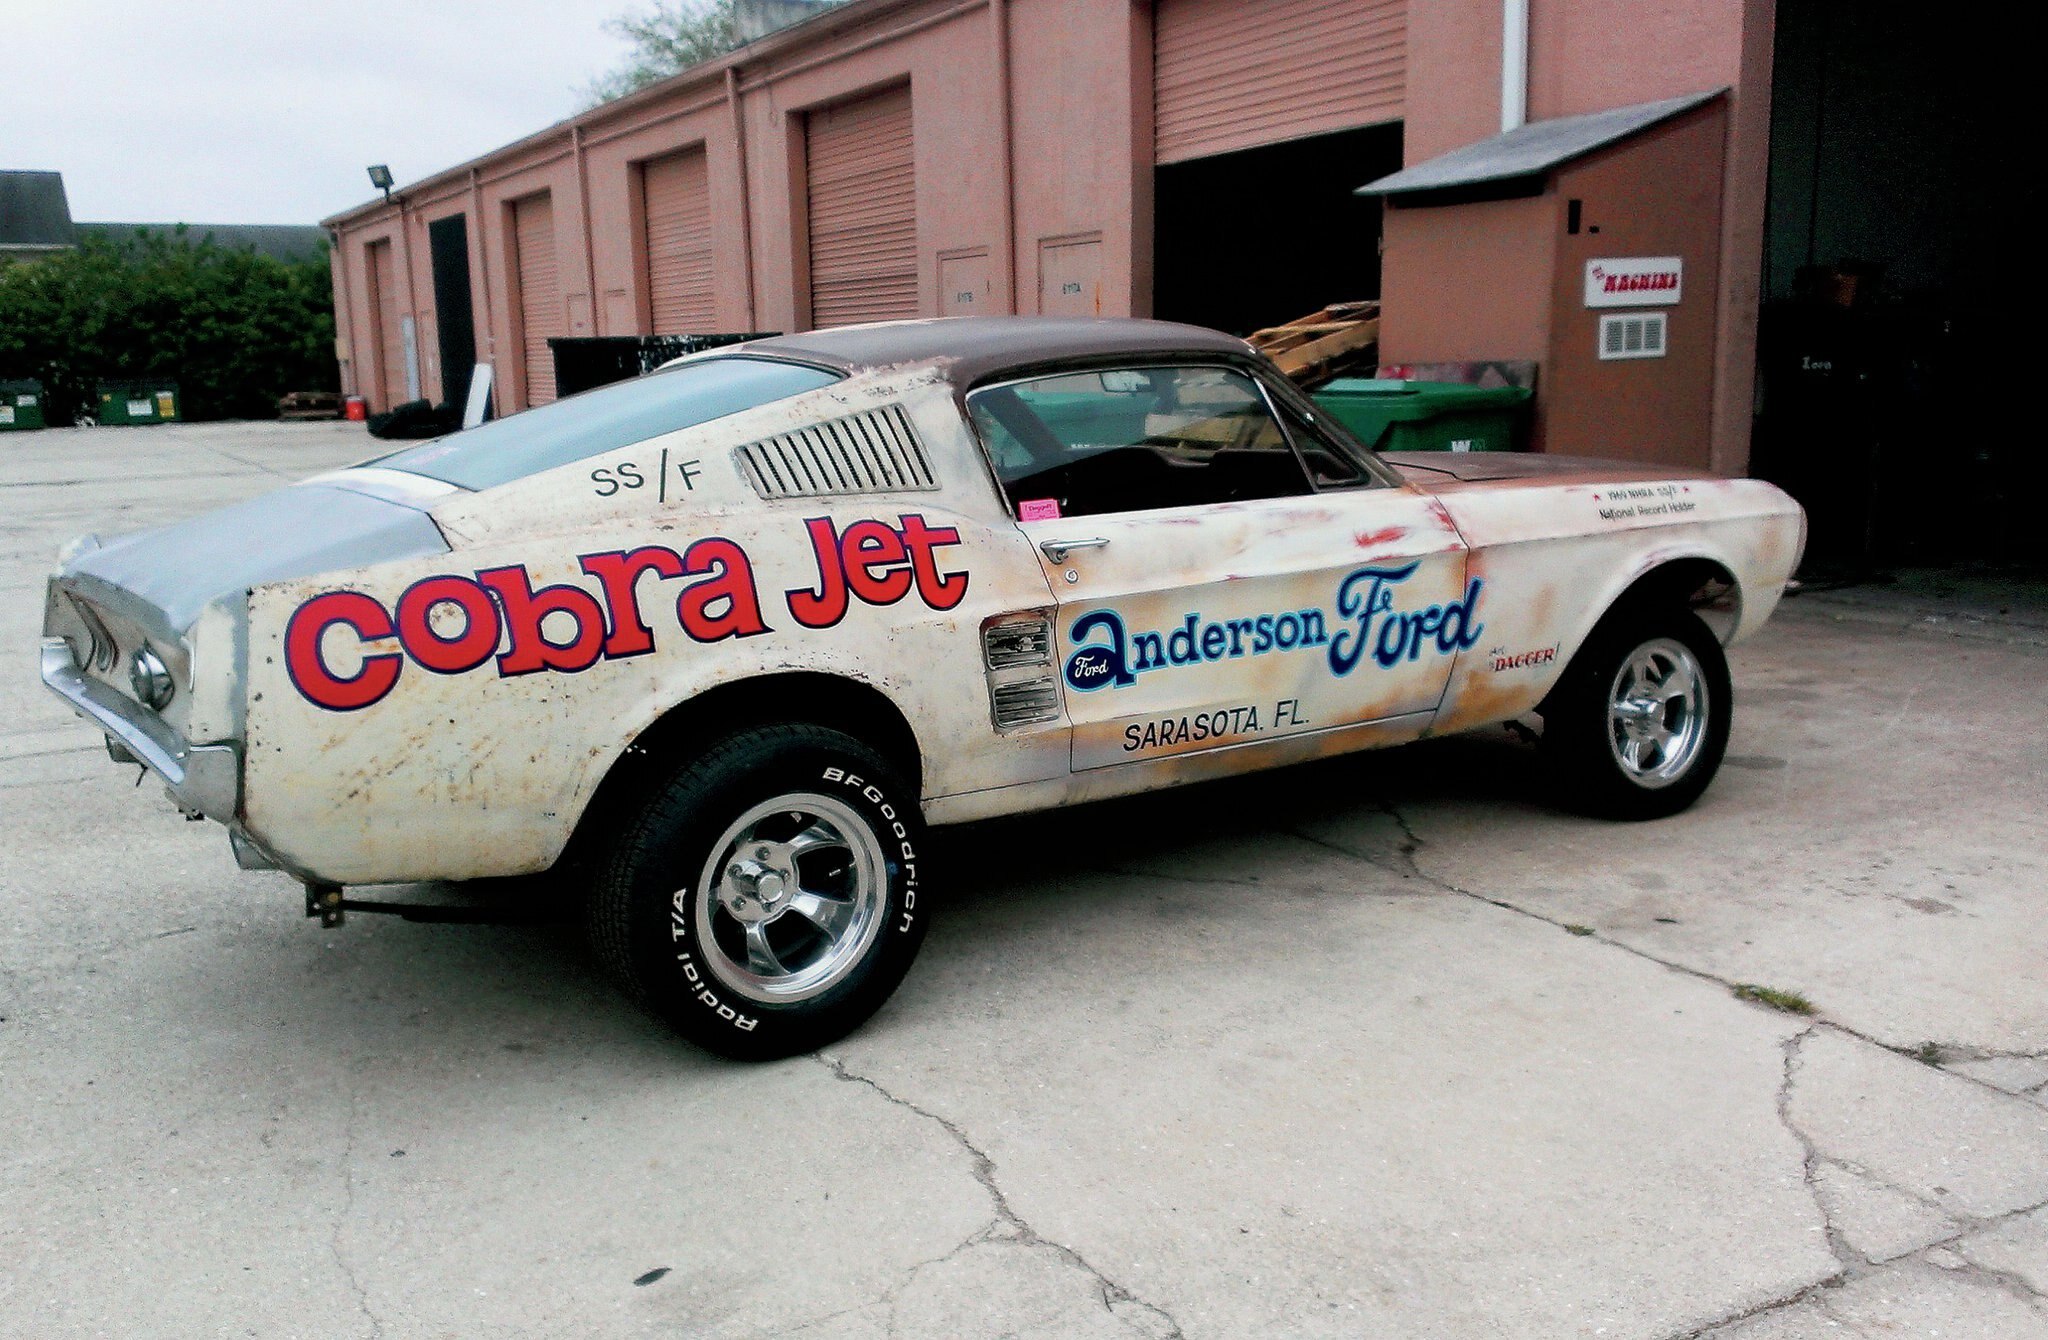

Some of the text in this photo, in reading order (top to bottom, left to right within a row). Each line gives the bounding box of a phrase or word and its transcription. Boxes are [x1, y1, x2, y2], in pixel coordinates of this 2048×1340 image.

[590, 448, 702, 503] SS/F
[1599, 501, 1697, 521] National Record Holder
[785, 513, 970, 629] Jet
[1328, 560, 1484, 678] Ford
[1073, 656, 1110, 679] Ford
[822, 766, 919, 933] BFGoodrich
[670, 887, 687, 942] T/A
